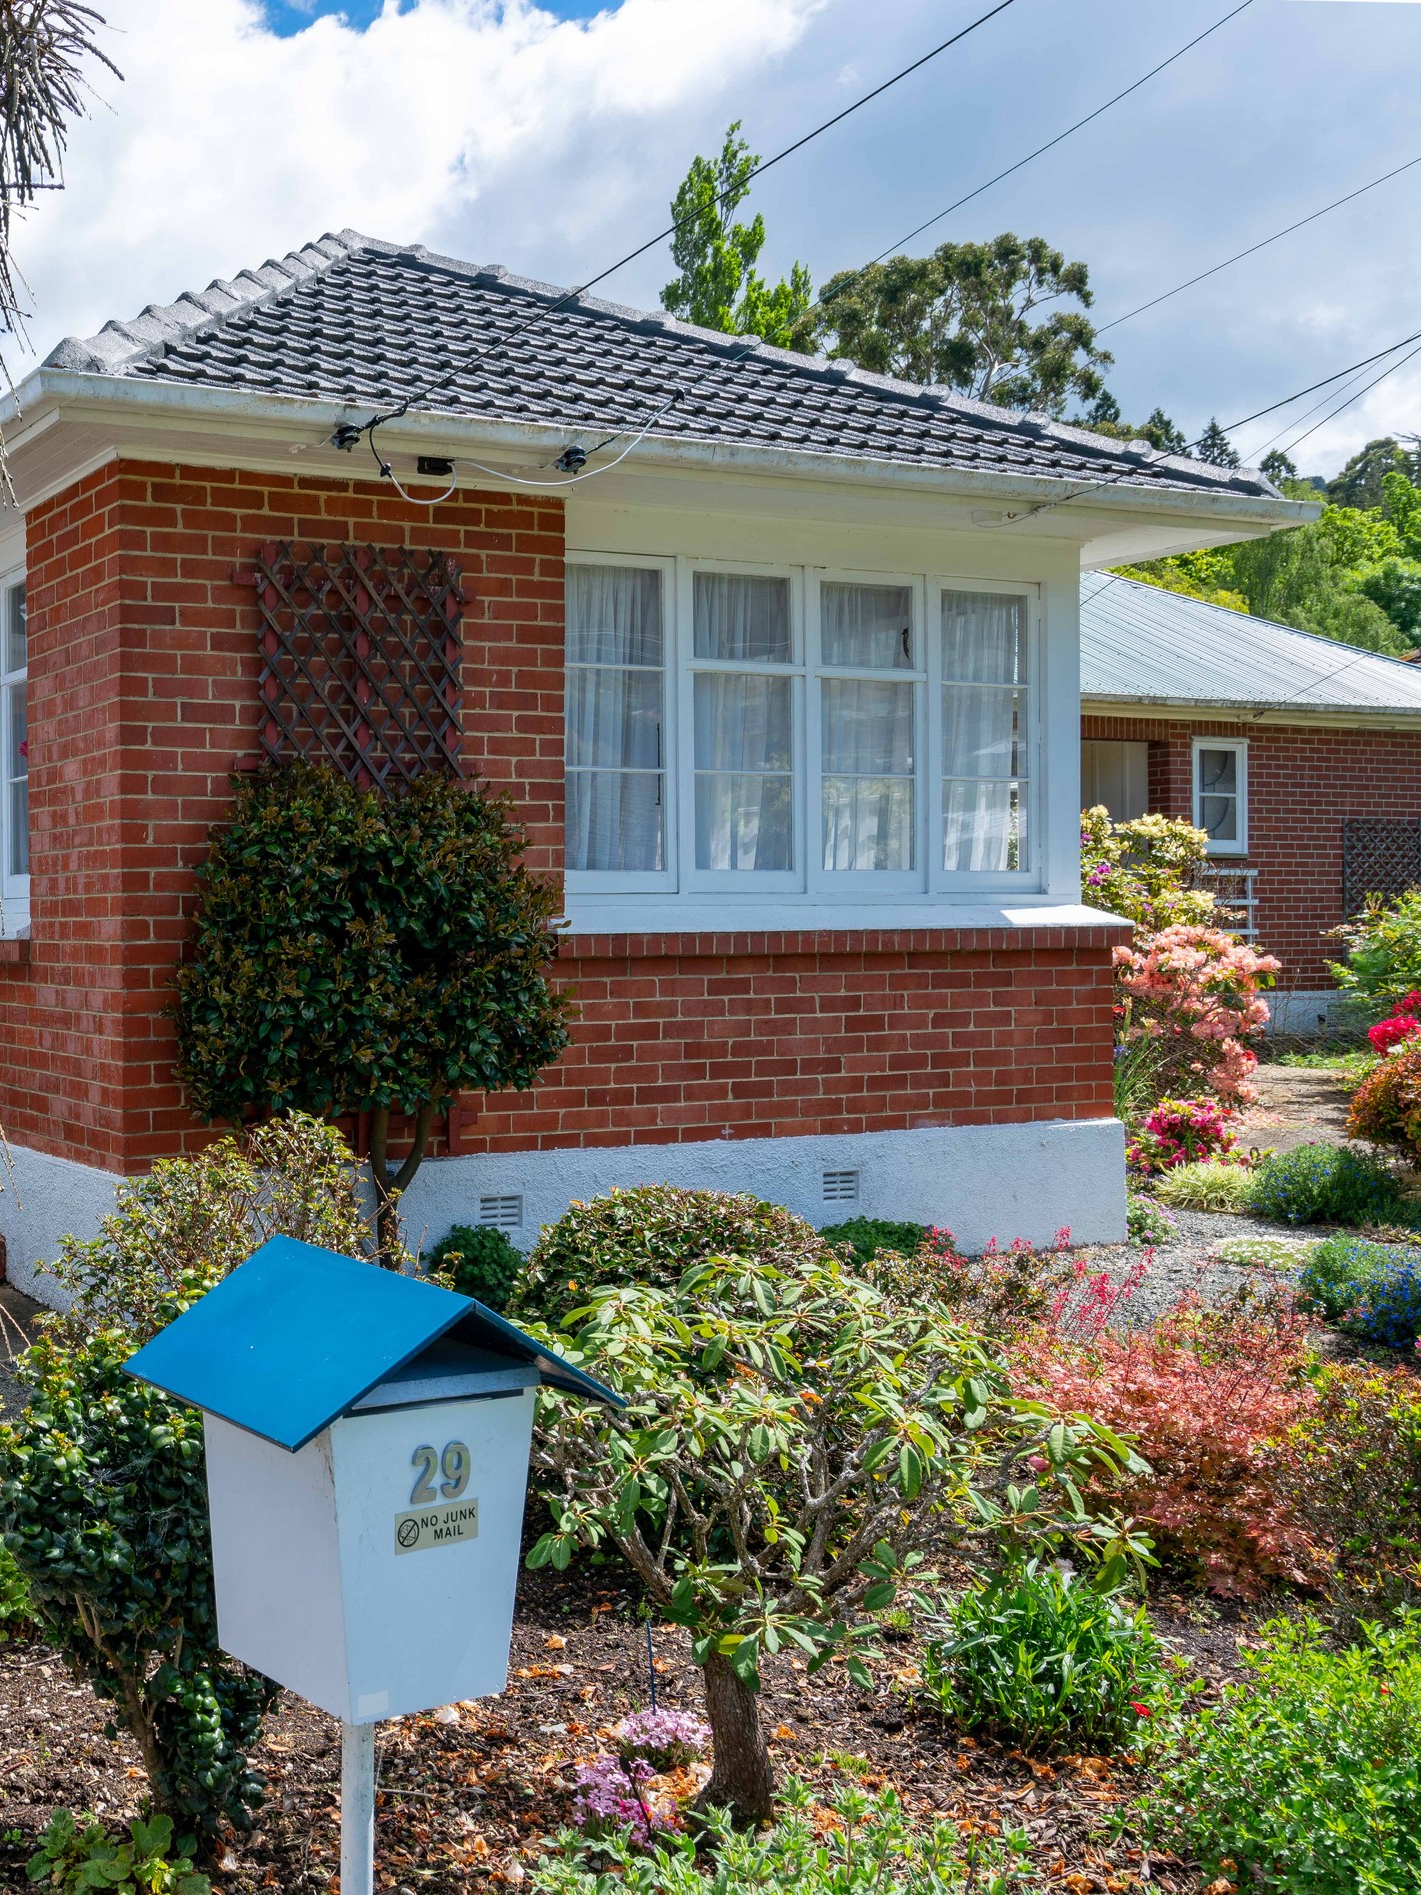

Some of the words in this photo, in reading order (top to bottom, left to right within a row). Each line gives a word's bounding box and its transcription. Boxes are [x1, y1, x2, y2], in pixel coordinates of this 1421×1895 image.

[410, 1441, 471, 1505] 29
[421, 1515, 438, 1529] NO
[443, 1507, 476, 1524] JUNK
[434, 1524, 464, 1540] MAIL
